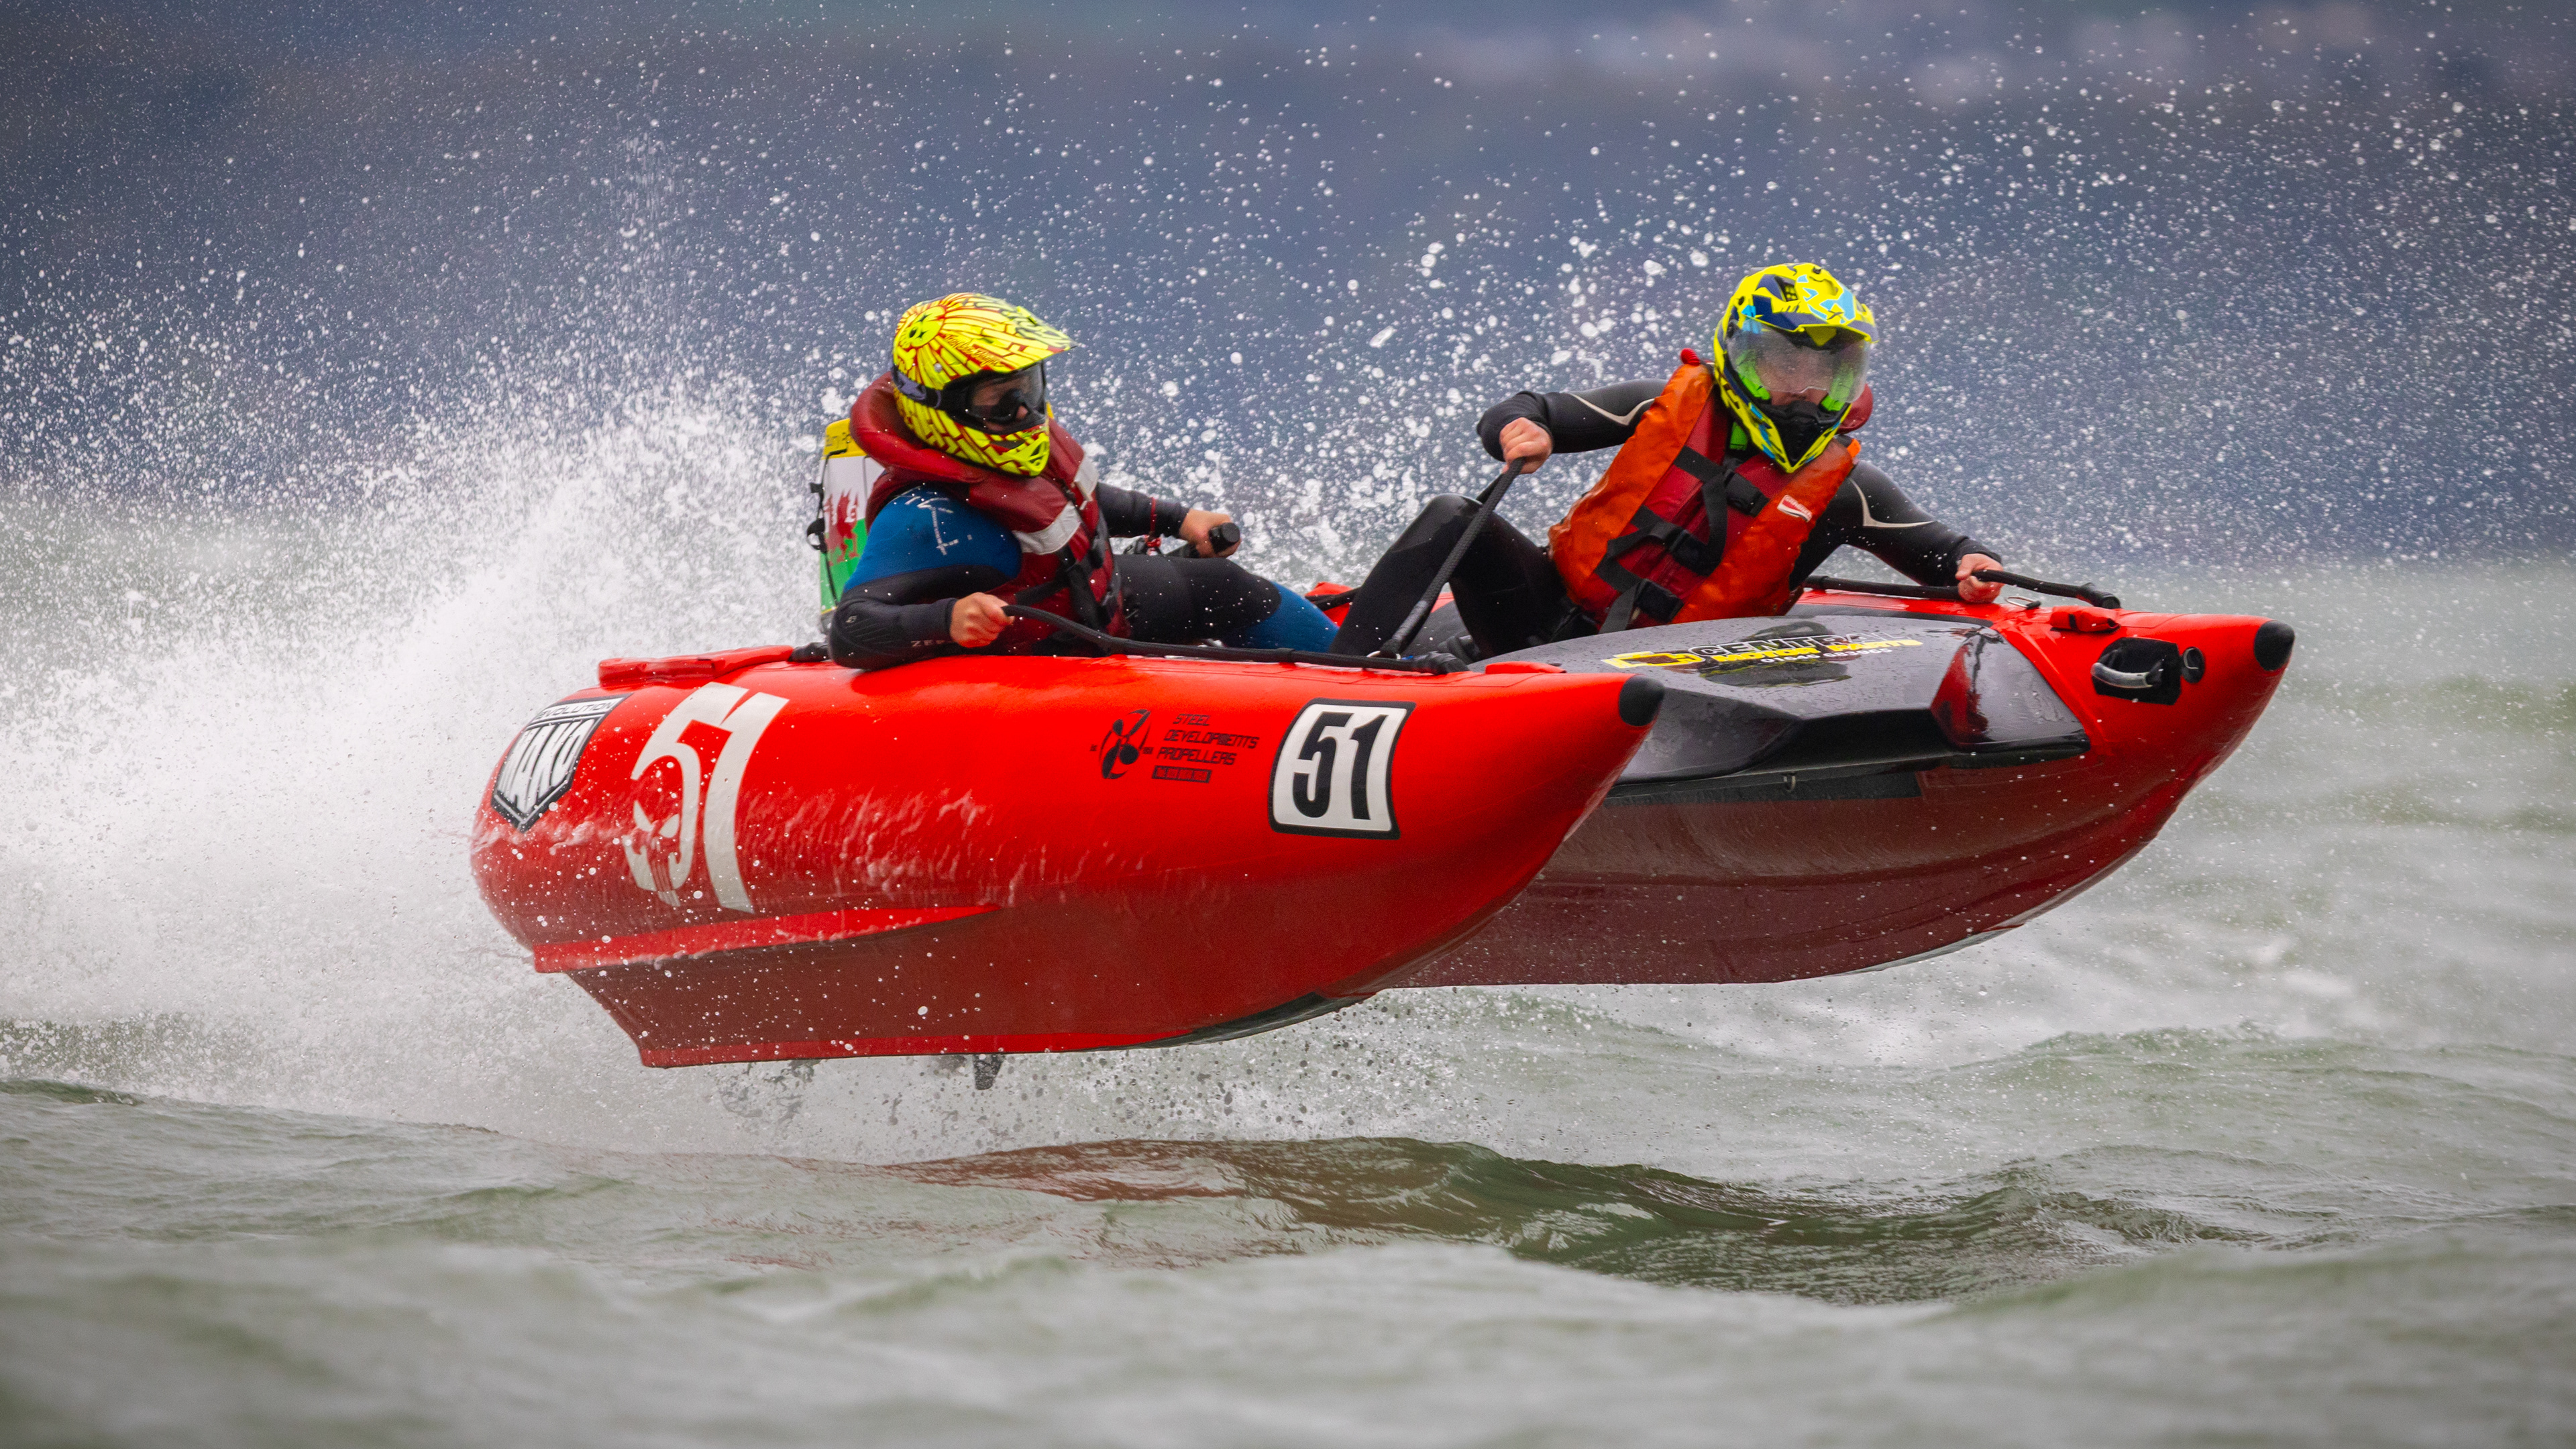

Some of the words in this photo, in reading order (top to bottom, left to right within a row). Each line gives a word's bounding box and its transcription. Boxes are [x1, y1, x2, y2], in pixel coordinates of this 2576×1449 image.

[1688, 632, 1912, 657] CENTRAL
[1711, 647, 1820, 662] MOTOR
[1825, 639, 1924, 651] PARTS
[1173, 713, 1210, 726] STEEL
[1163, 729, 1260, 749] DEVELOPMENTS
[1157, 746, 1237, 765] PROPELLERS
[1292, 711, 1389, 820] 51
